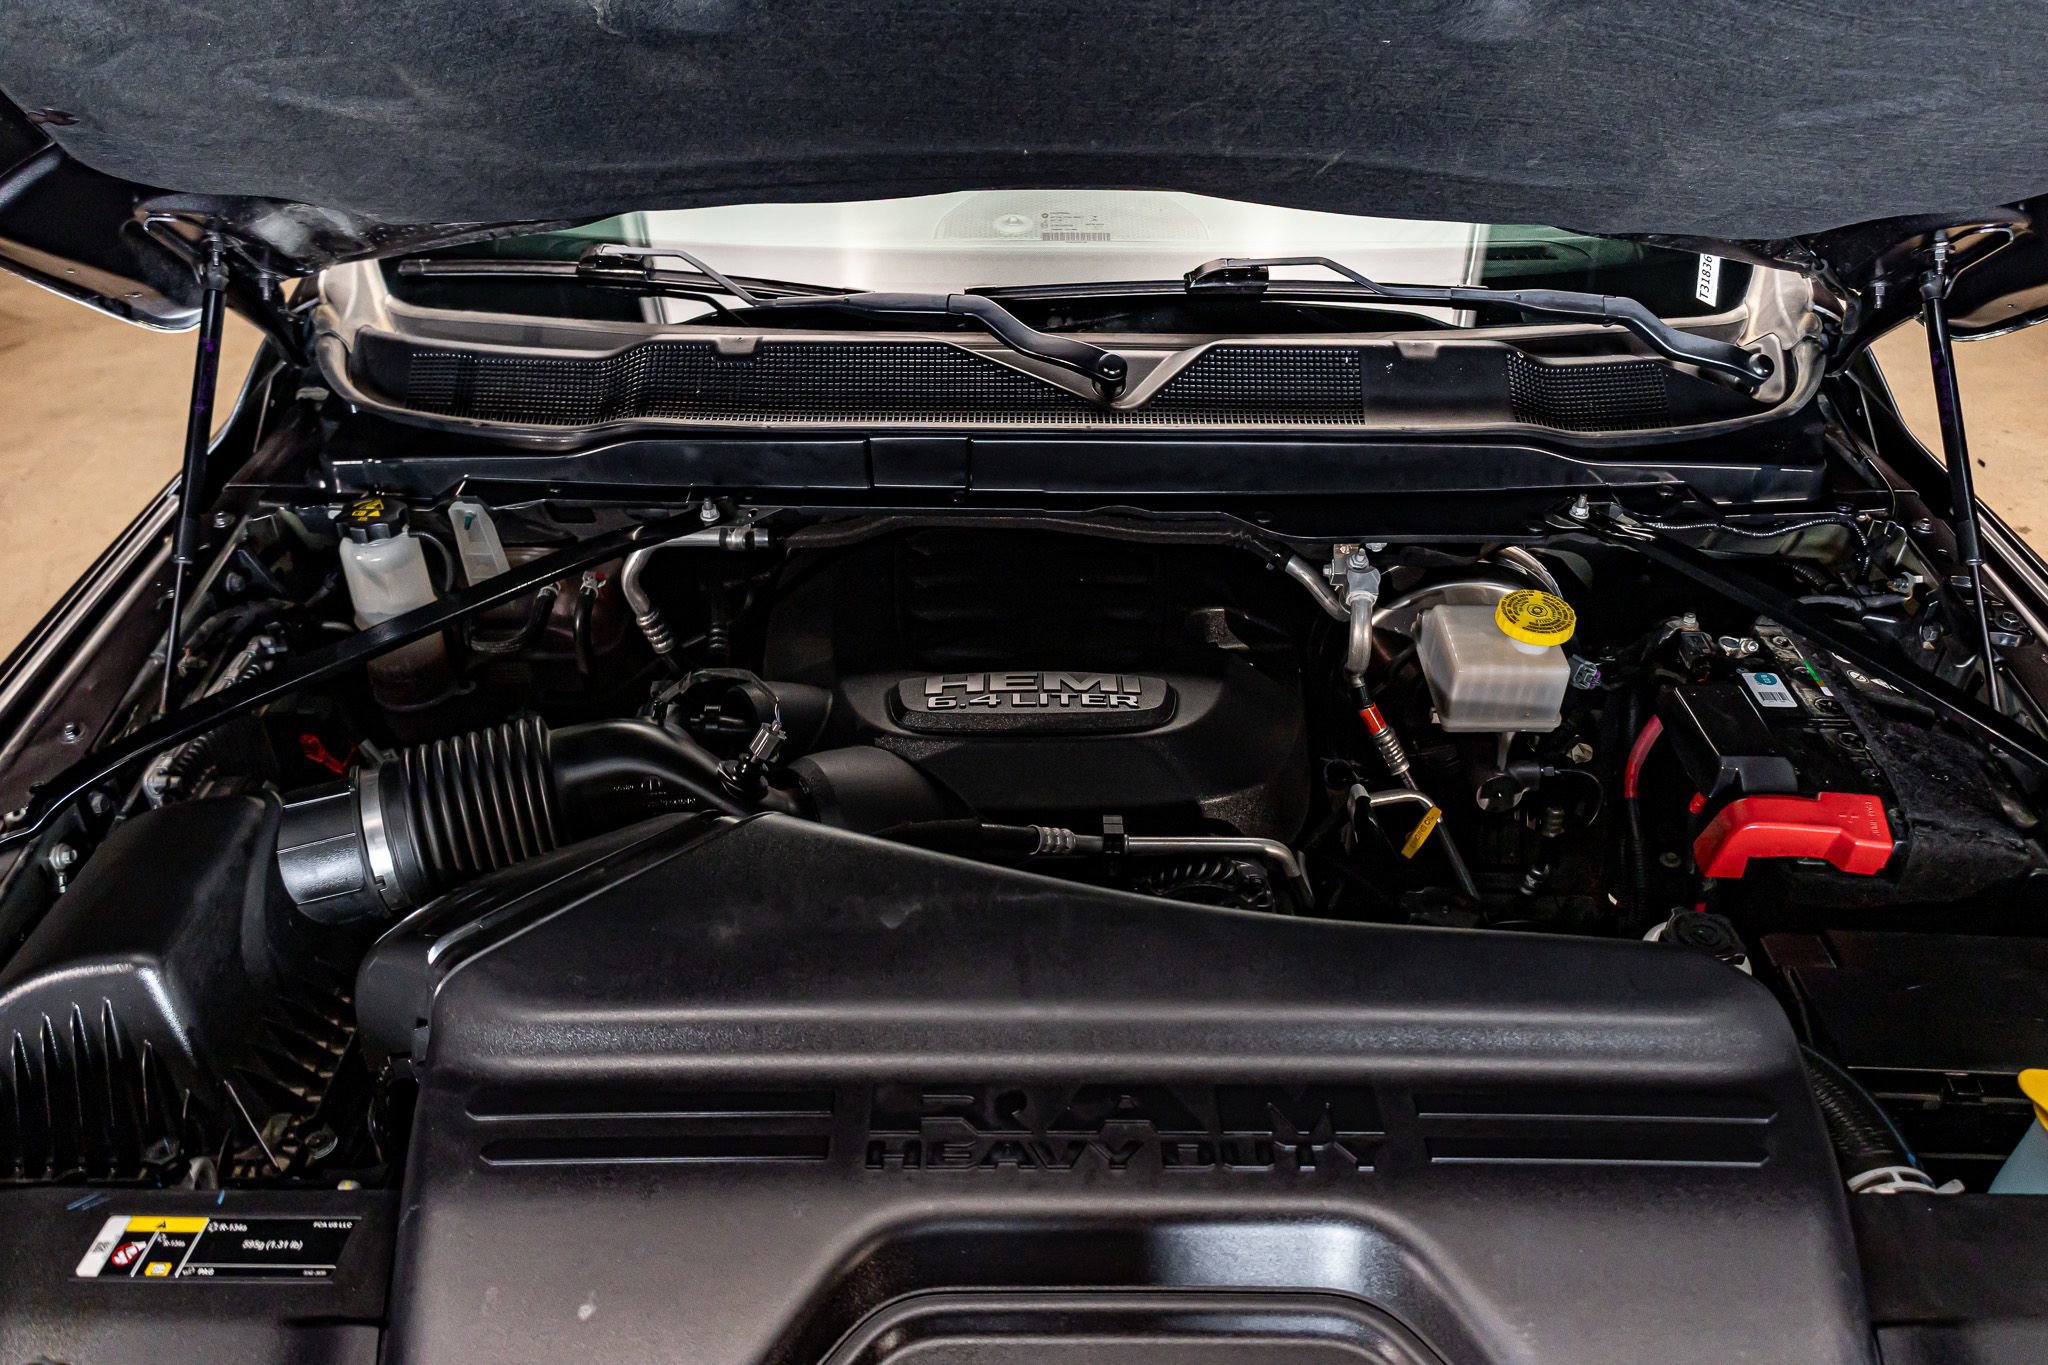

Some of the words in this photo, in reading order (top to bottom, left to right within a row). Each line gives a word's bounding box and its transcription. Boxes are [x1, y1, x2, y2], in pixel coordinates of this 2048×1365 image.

[1699, 254, 1713, 298] T31836
[924, 672, 1142, 694] HEMI
[927, 693, 1001, 709] 6.4
[1011, 693, 1140, 708] LITER
[868, 1083, 1386, 1137] RAM
[865, 1139, 1145, 1171] HEAVY
[1161, 1139, 1379, 1172] DUTY
